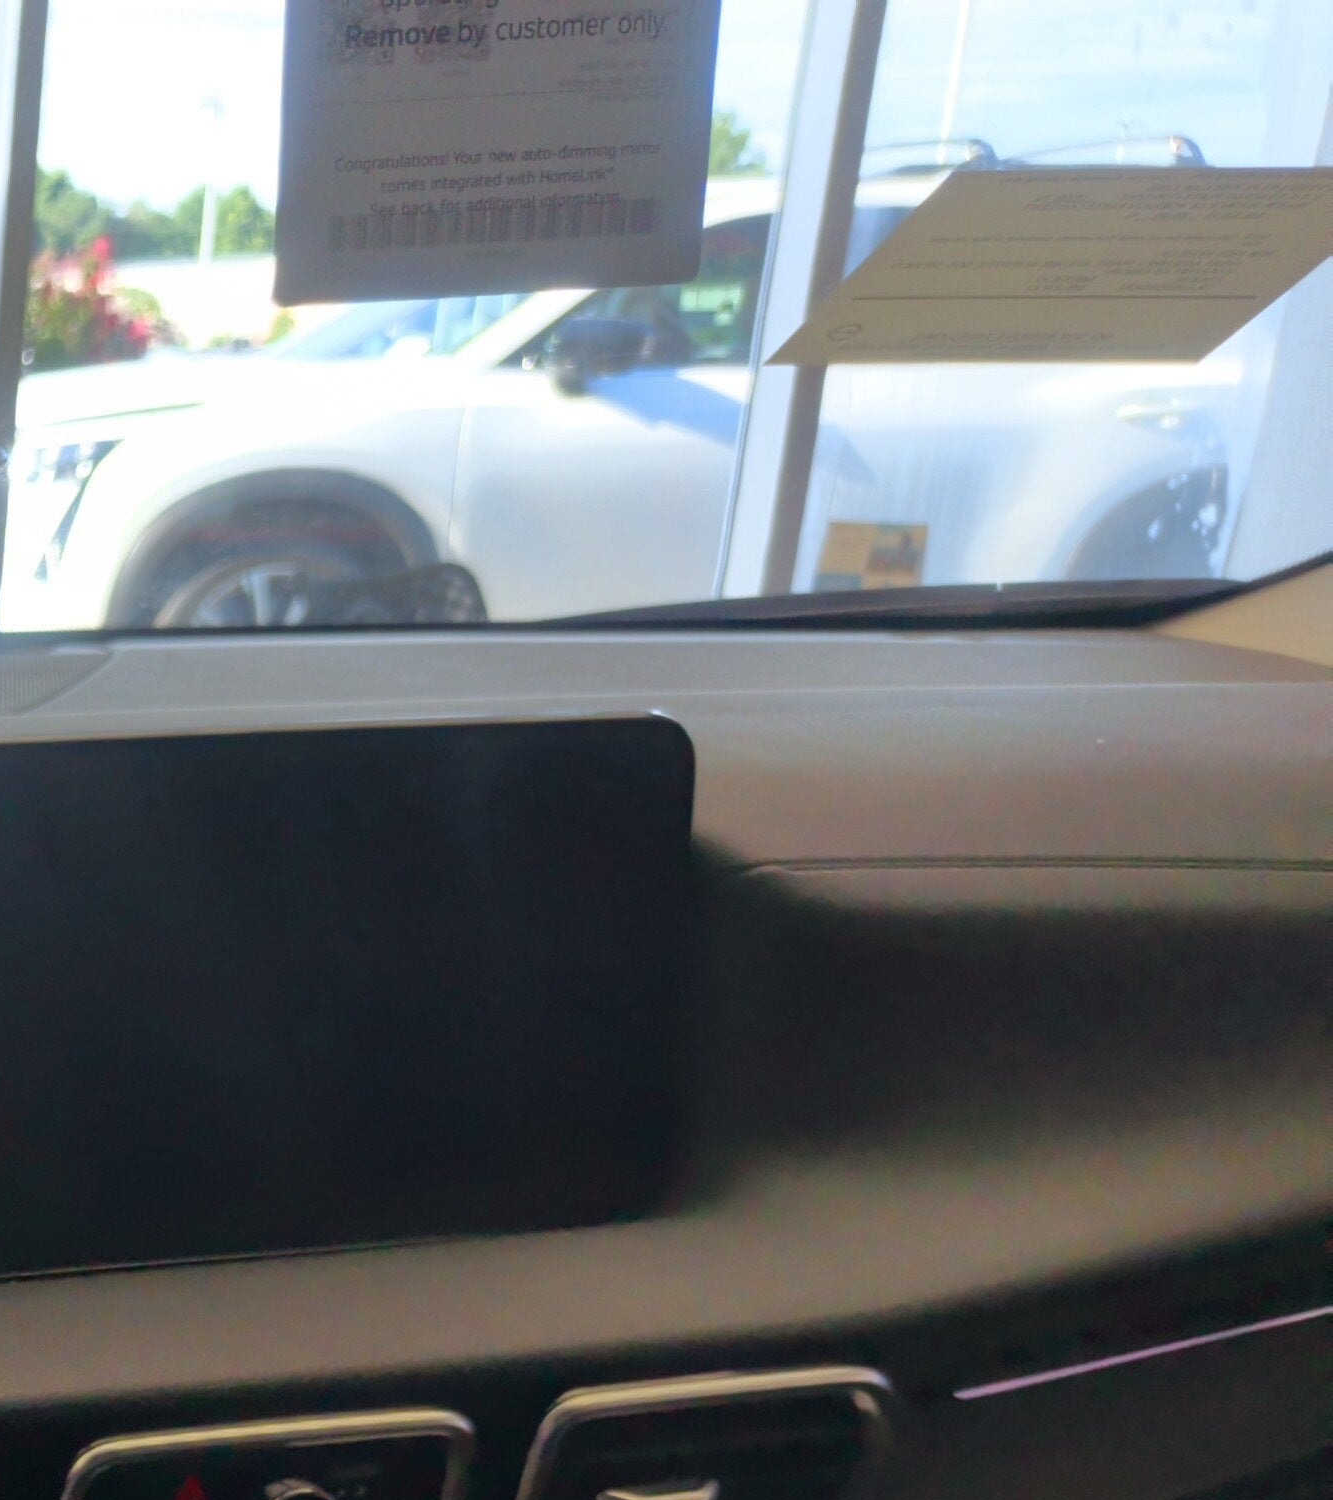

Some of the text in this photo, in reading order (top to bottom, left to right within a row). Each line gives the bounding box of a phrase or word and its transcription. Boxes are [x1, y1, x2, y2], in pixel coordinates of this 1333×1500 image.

[345, 24, 451, 48] Remove
[458, 19, 487, 48] by
[496, 16, 612, 41] customer
[452, 148, 484, 165] Your
[487, 148, 518, 163] new
[520, 144, 617, 161] auto-dimming
[619, 142, 661, 157] mirror
[379, 179, 427, 194] comes
[430, 173, 503, 193] integrated
[505, 169, 536, 186] with
[369, 202, 395, 218] See
[401, 200, 435, 217] back
[439, 198, 461, 216] for
[465, 195, 536, 214] additional
